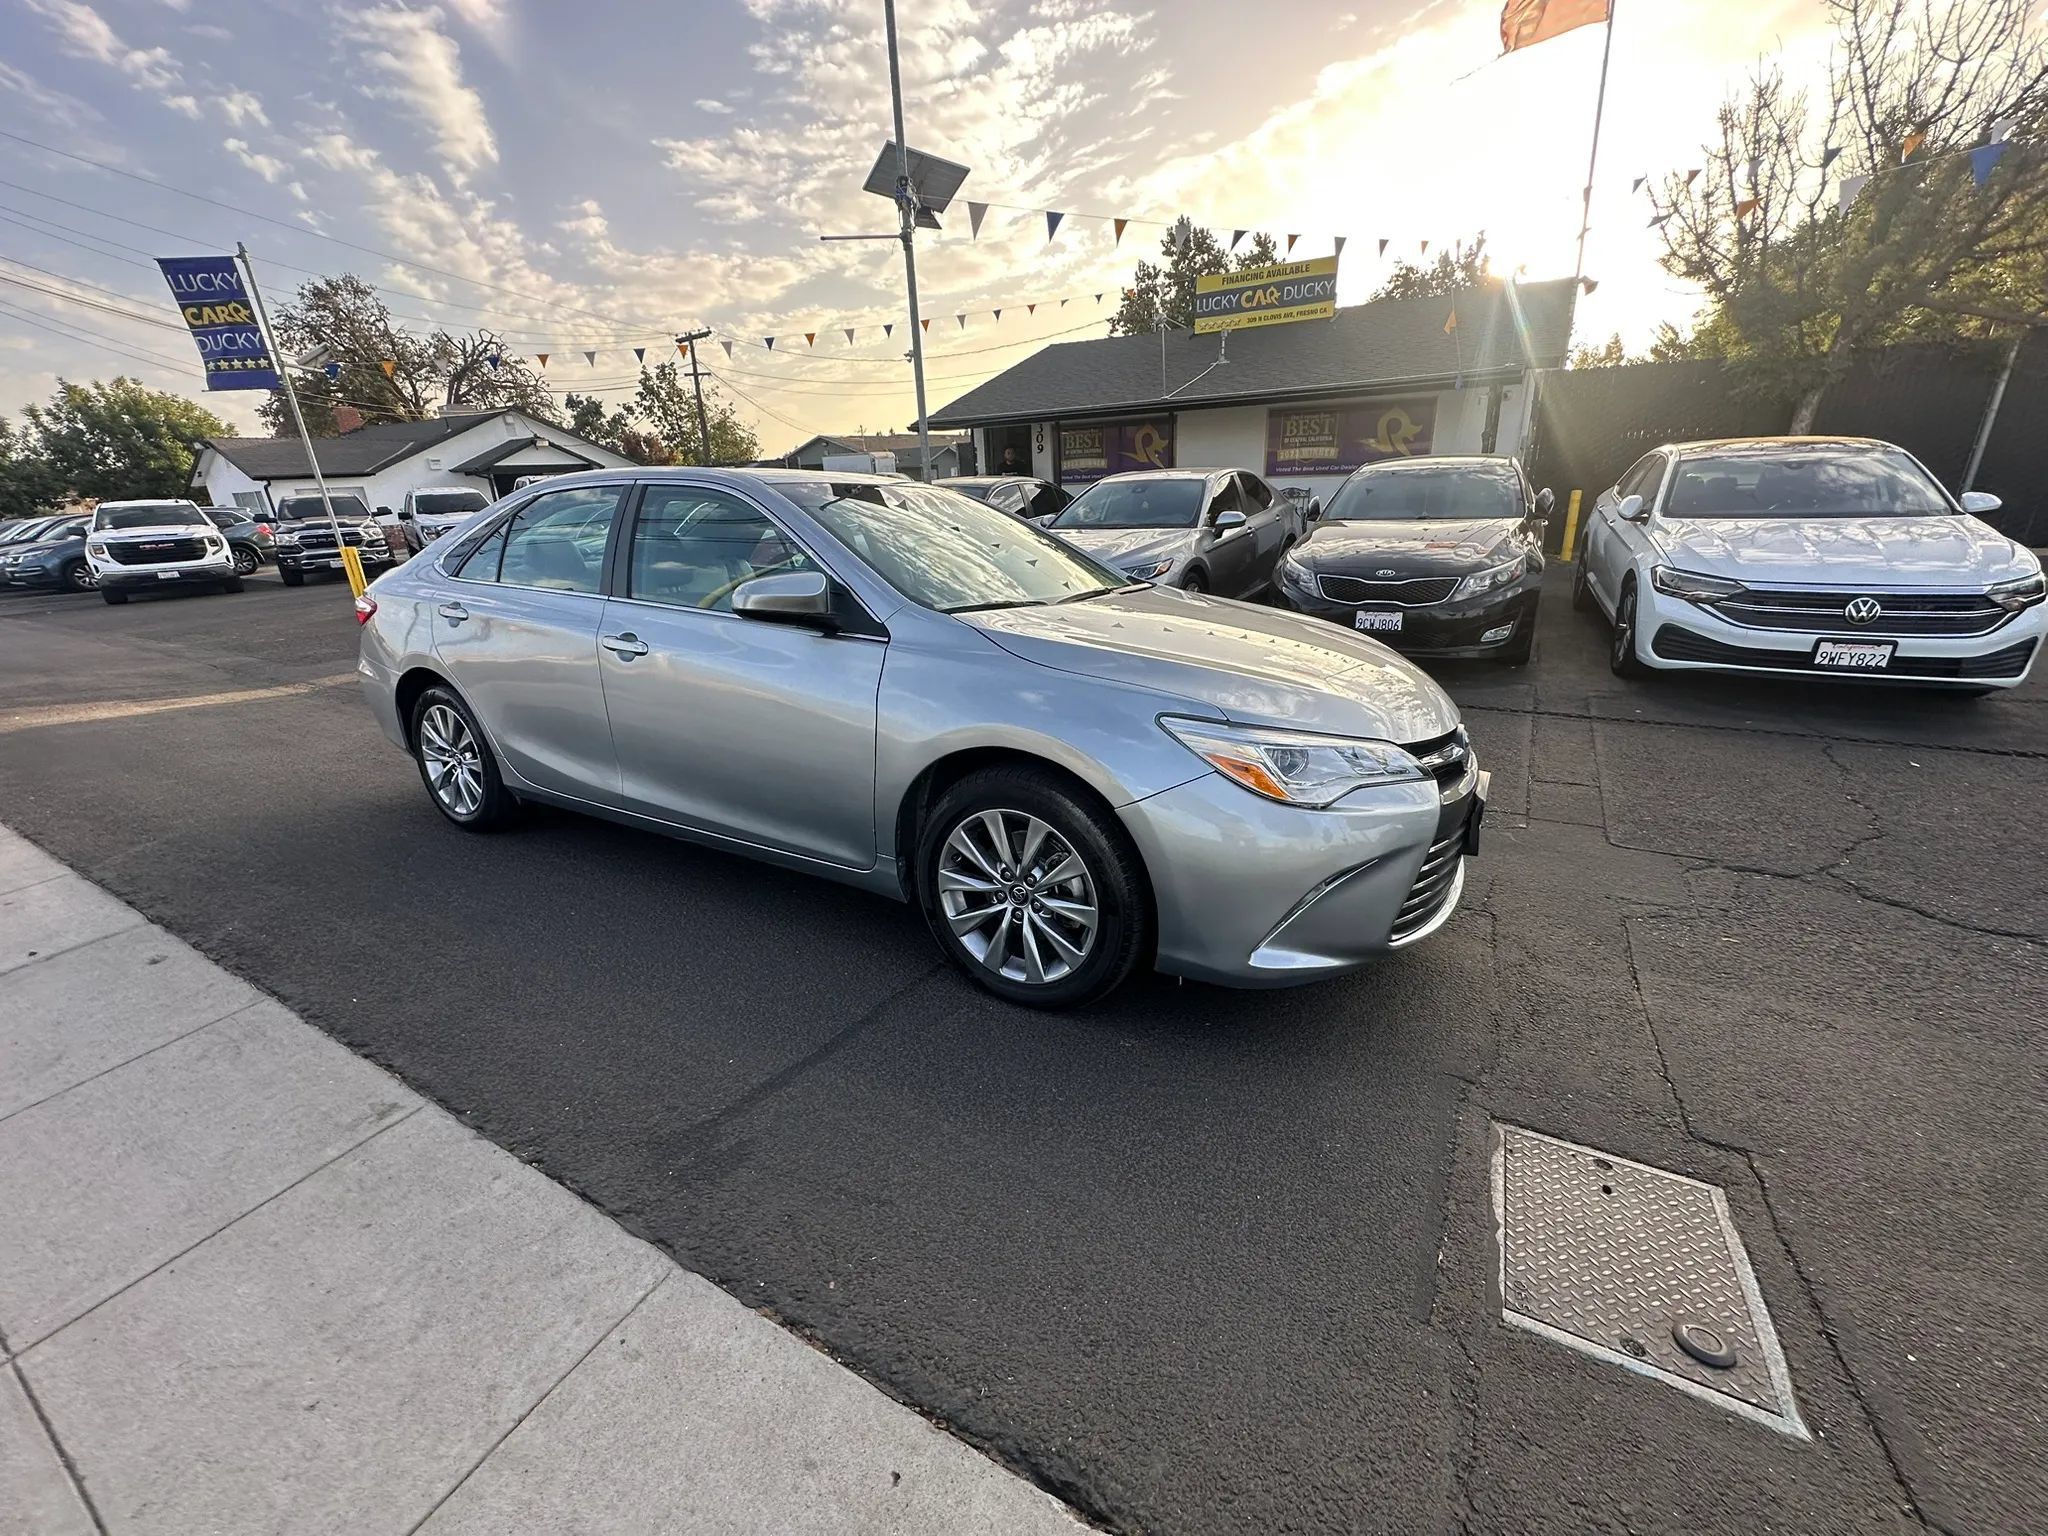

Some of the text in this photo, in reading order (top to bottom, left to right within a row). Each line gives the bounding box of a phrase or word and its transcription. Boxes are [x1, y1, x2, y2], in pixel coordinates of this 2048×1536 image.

[167, 272, 239, 292] LUCKY
[1221, 264, 1310, 285] FINANCING AVAILABLE
[1196, 293, 1239, 313] LUCKY
[1284, 280, 1334, 300] DUCKY
[195, 332, 261, 352] DUCKY
[1285, 418, 1335, 436] BEST
[1065, 433, 1101, 448] BEST
[1357, 617, 1400, 630] 9CWJ806
[1819, 651, 1887, 667] 9WFY822
